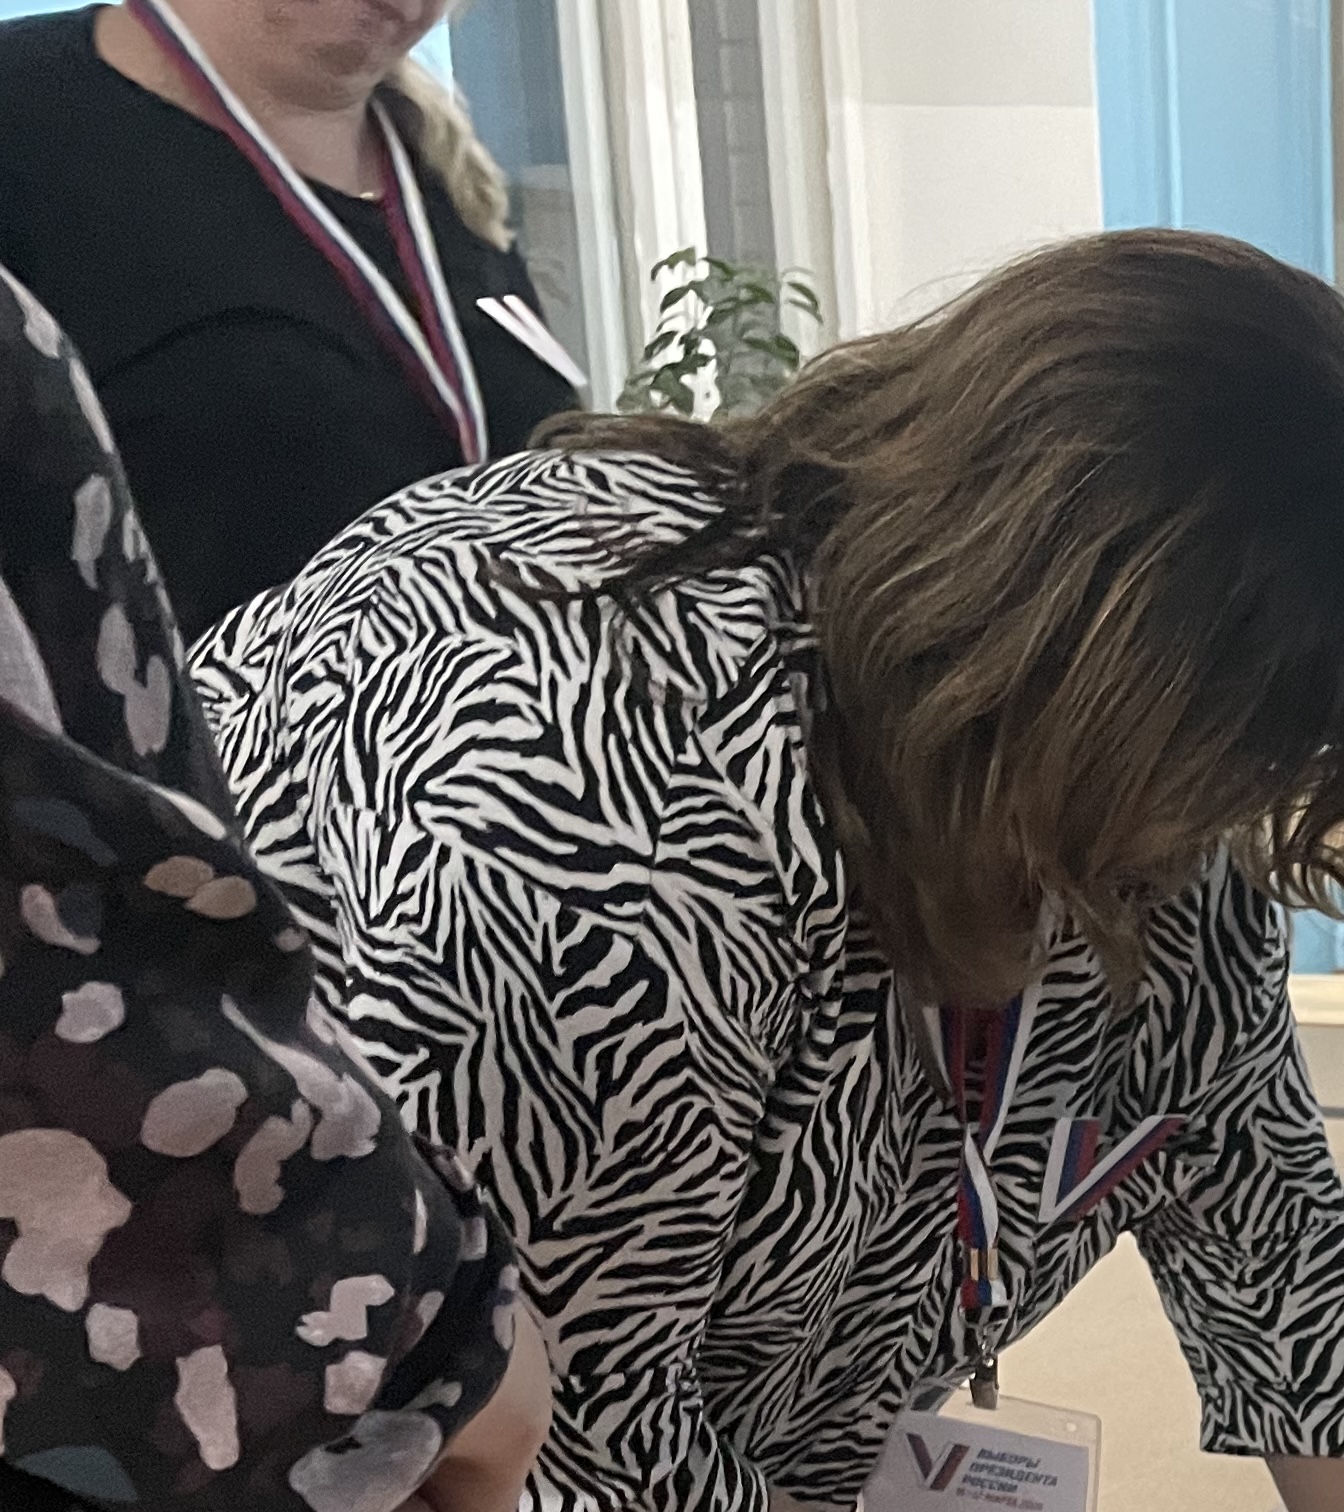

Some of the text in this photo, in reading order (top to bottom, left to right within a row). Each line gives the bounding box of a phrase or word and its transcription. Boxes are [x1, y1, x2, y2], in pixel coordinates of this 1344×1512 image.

[977, 1448, 1041, 1468] ВЫБОРЫ
[961, 1474, 1018, 1493] РОССИИ
[969, 1462, 1057, 1487] ПРЕЗИДЕНТА
